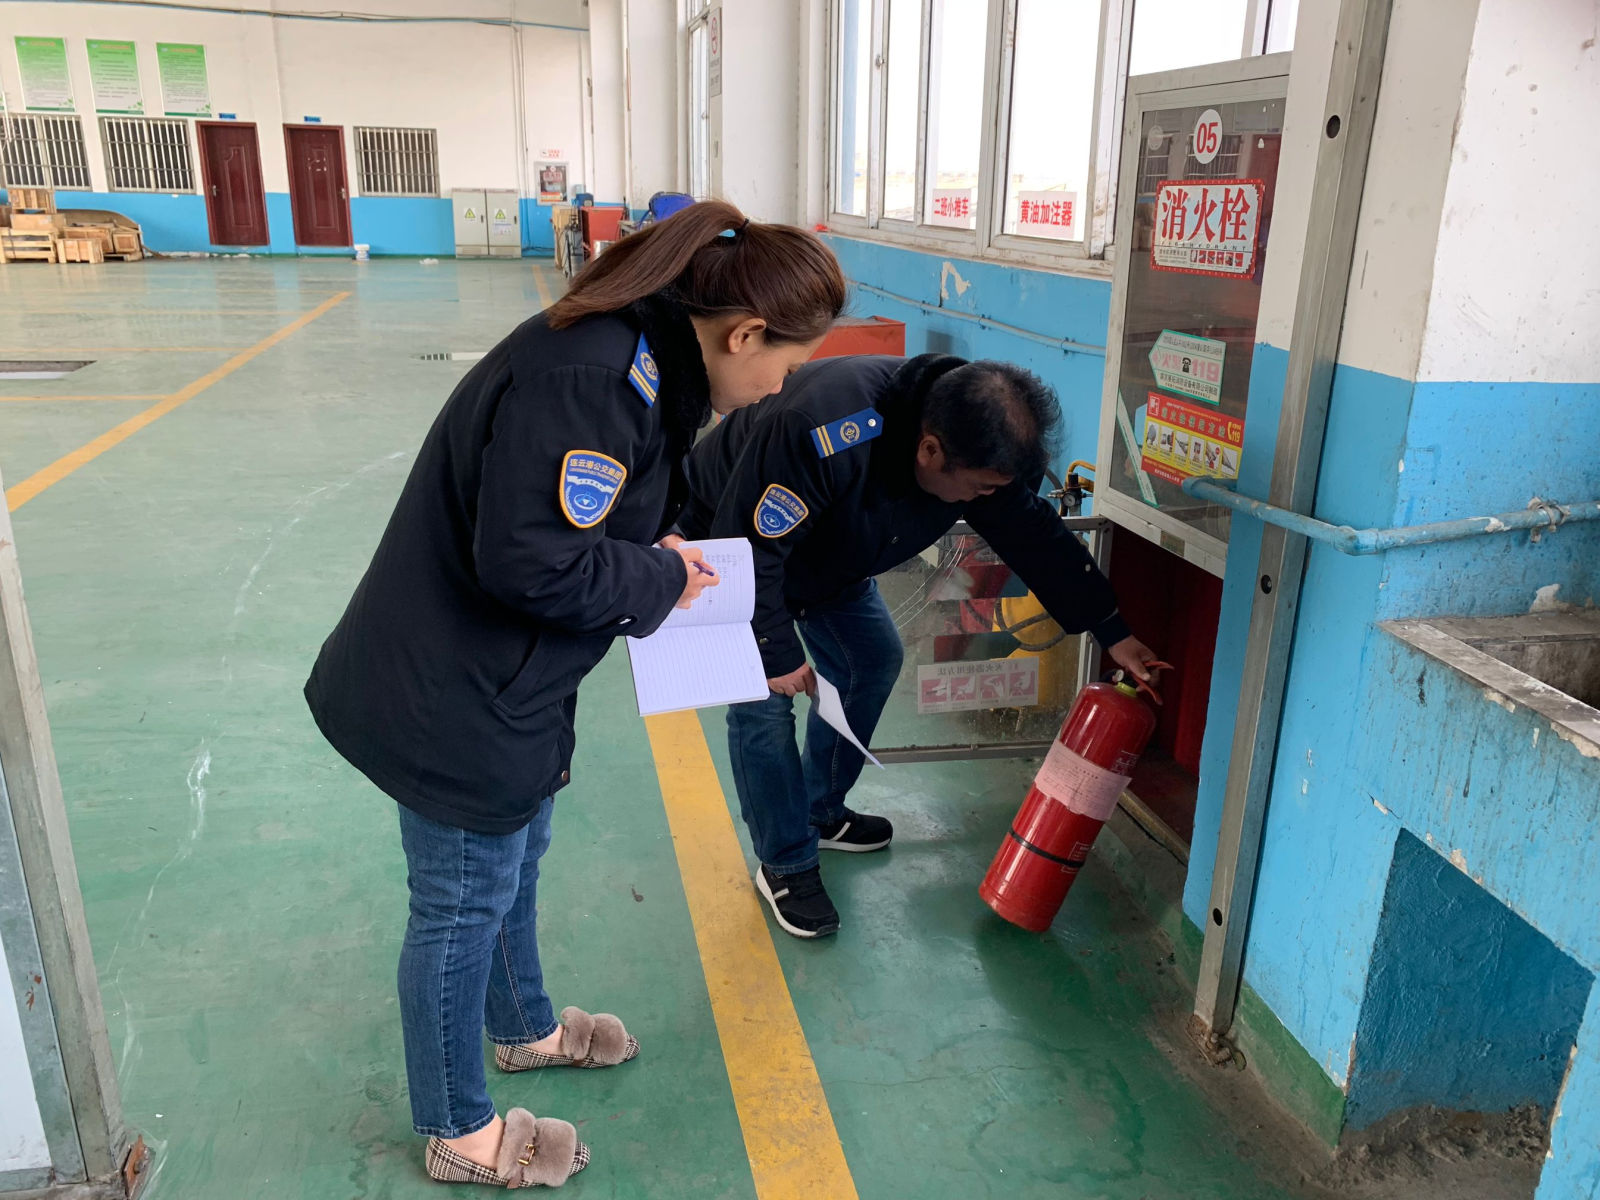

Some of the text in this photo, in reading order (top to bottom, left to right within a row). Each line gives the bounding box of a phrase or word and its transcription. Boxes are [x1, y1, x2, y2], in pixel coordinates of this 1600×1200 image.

[1196, 122, 1219, 154] 05
[934, 196, 969, 218] 二班小推车
[1020, 199, 1073, 227] 黄油加注器
[1161, 188, 1251, 243] 消火栓
[1191, 357, 1221, 383] 119
[1231, 430, 1241, 443] 119
[569, 458, 624, 481] 连云港公交集团
